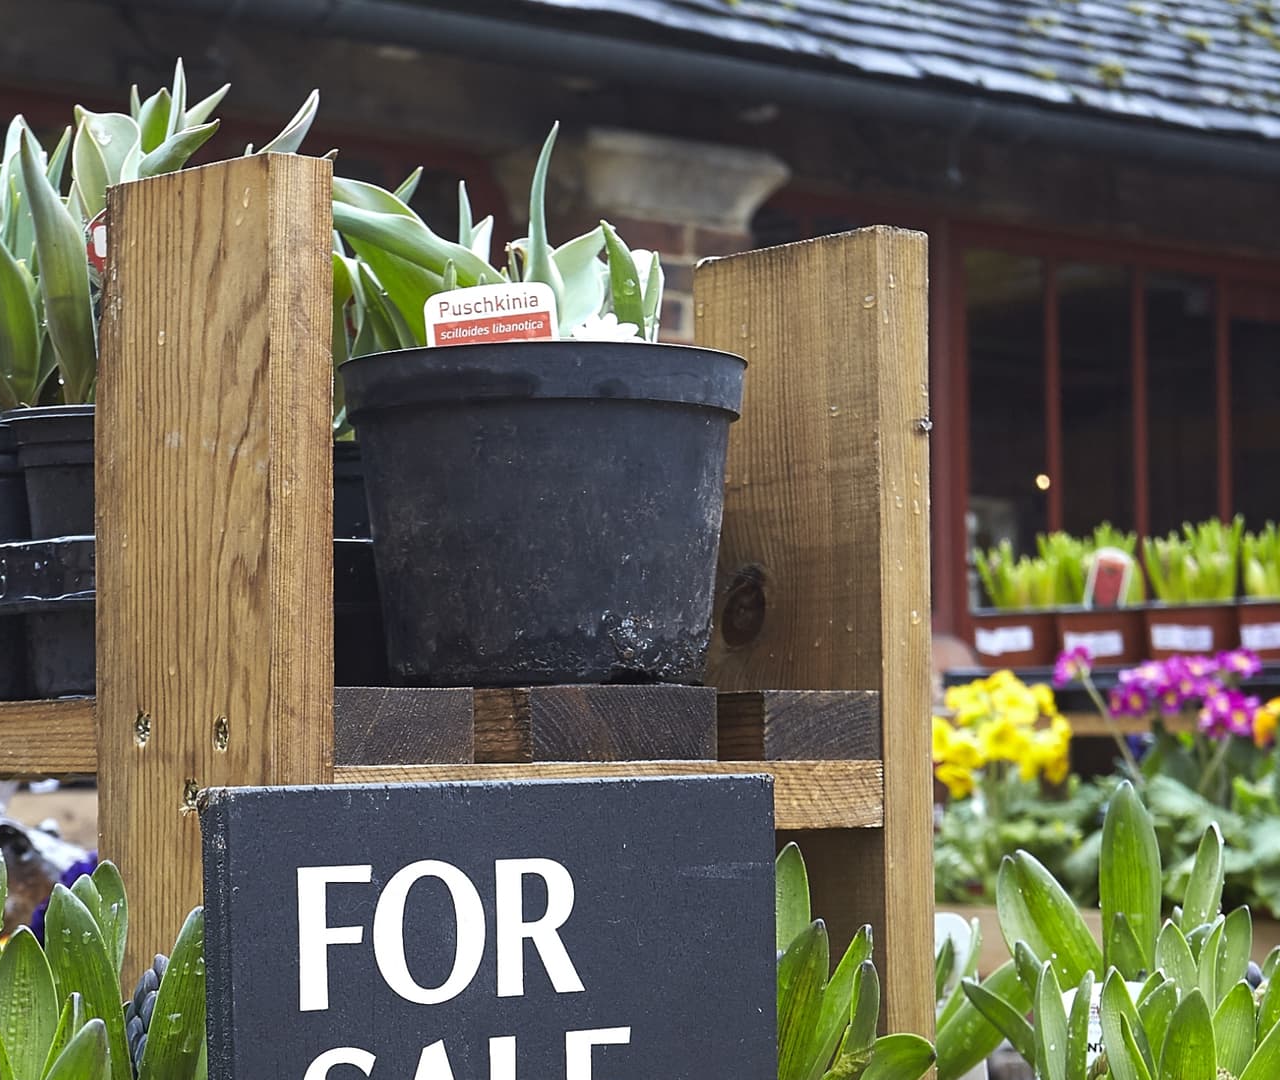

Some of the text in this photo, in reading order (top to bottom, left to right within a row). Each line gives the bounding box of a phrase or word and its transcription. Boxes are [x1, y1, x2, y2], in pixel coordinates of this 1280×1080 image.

[439, 292, 539, 318] Puschkinia
[440, 319, 544, 339] scilloides libanotica
[297, 858, 586, 1012] FOR
